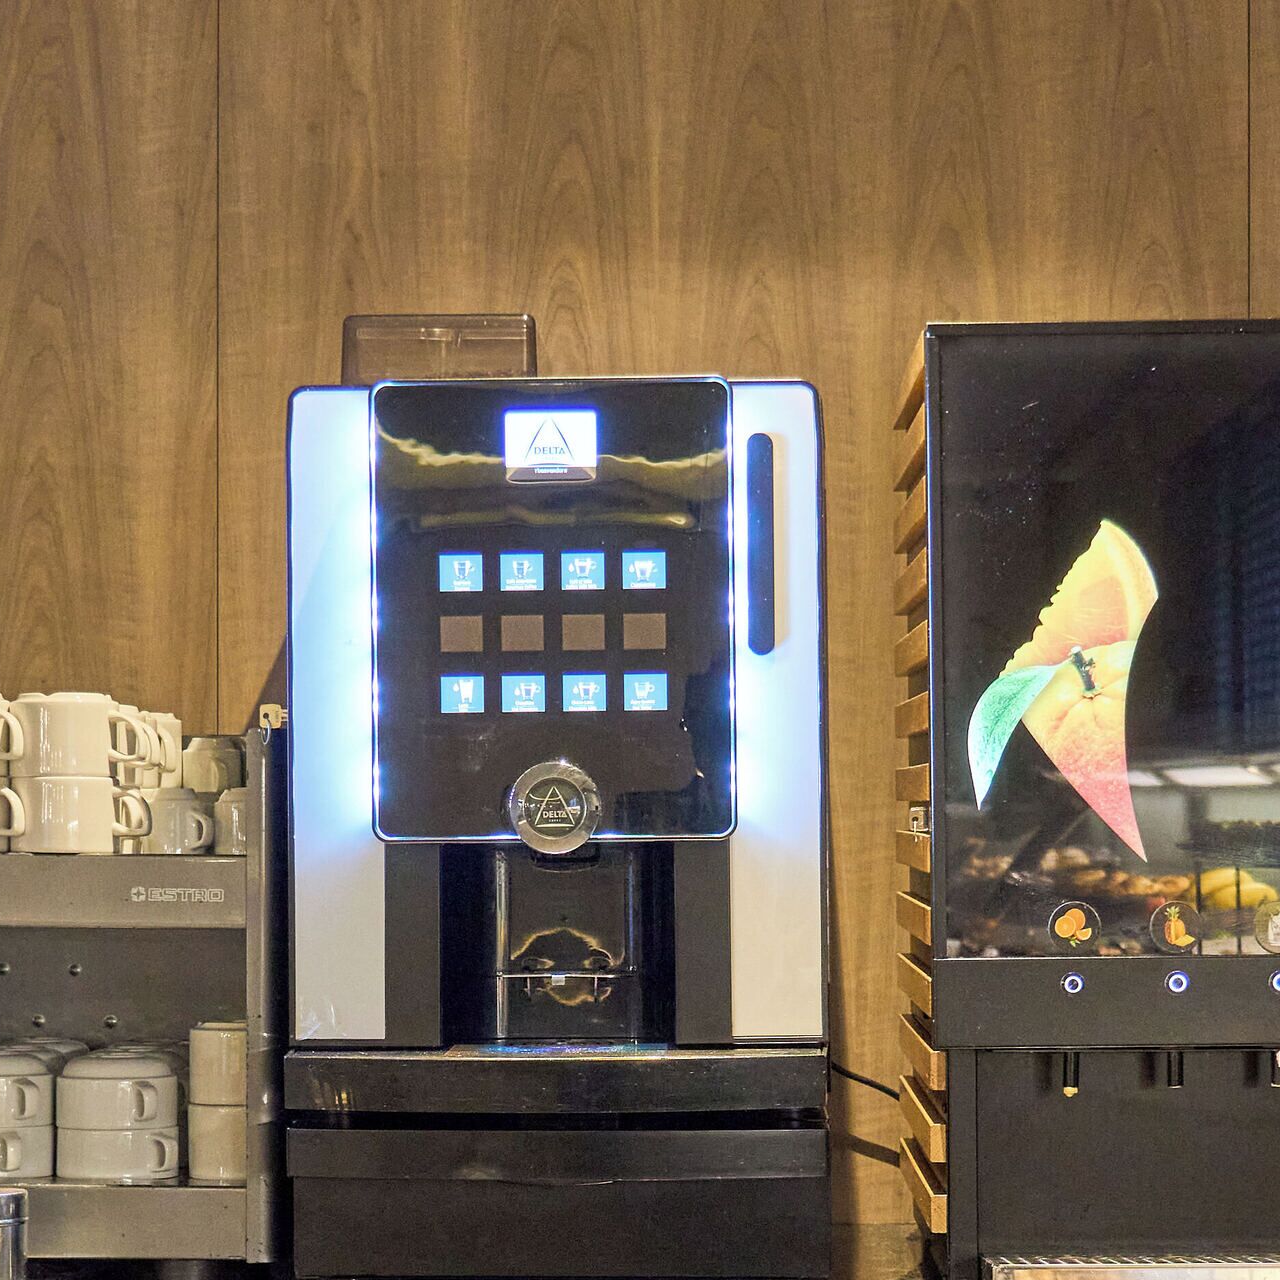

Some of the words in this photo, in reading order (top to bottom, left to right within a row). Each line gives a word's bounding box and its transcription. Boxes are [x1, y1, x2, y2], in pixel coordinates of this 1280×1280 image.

[534, 446, 565, 455] DELTA
[543, 810, 568, 818] DELTA
[148, 887, 224, 902] ESTRO
